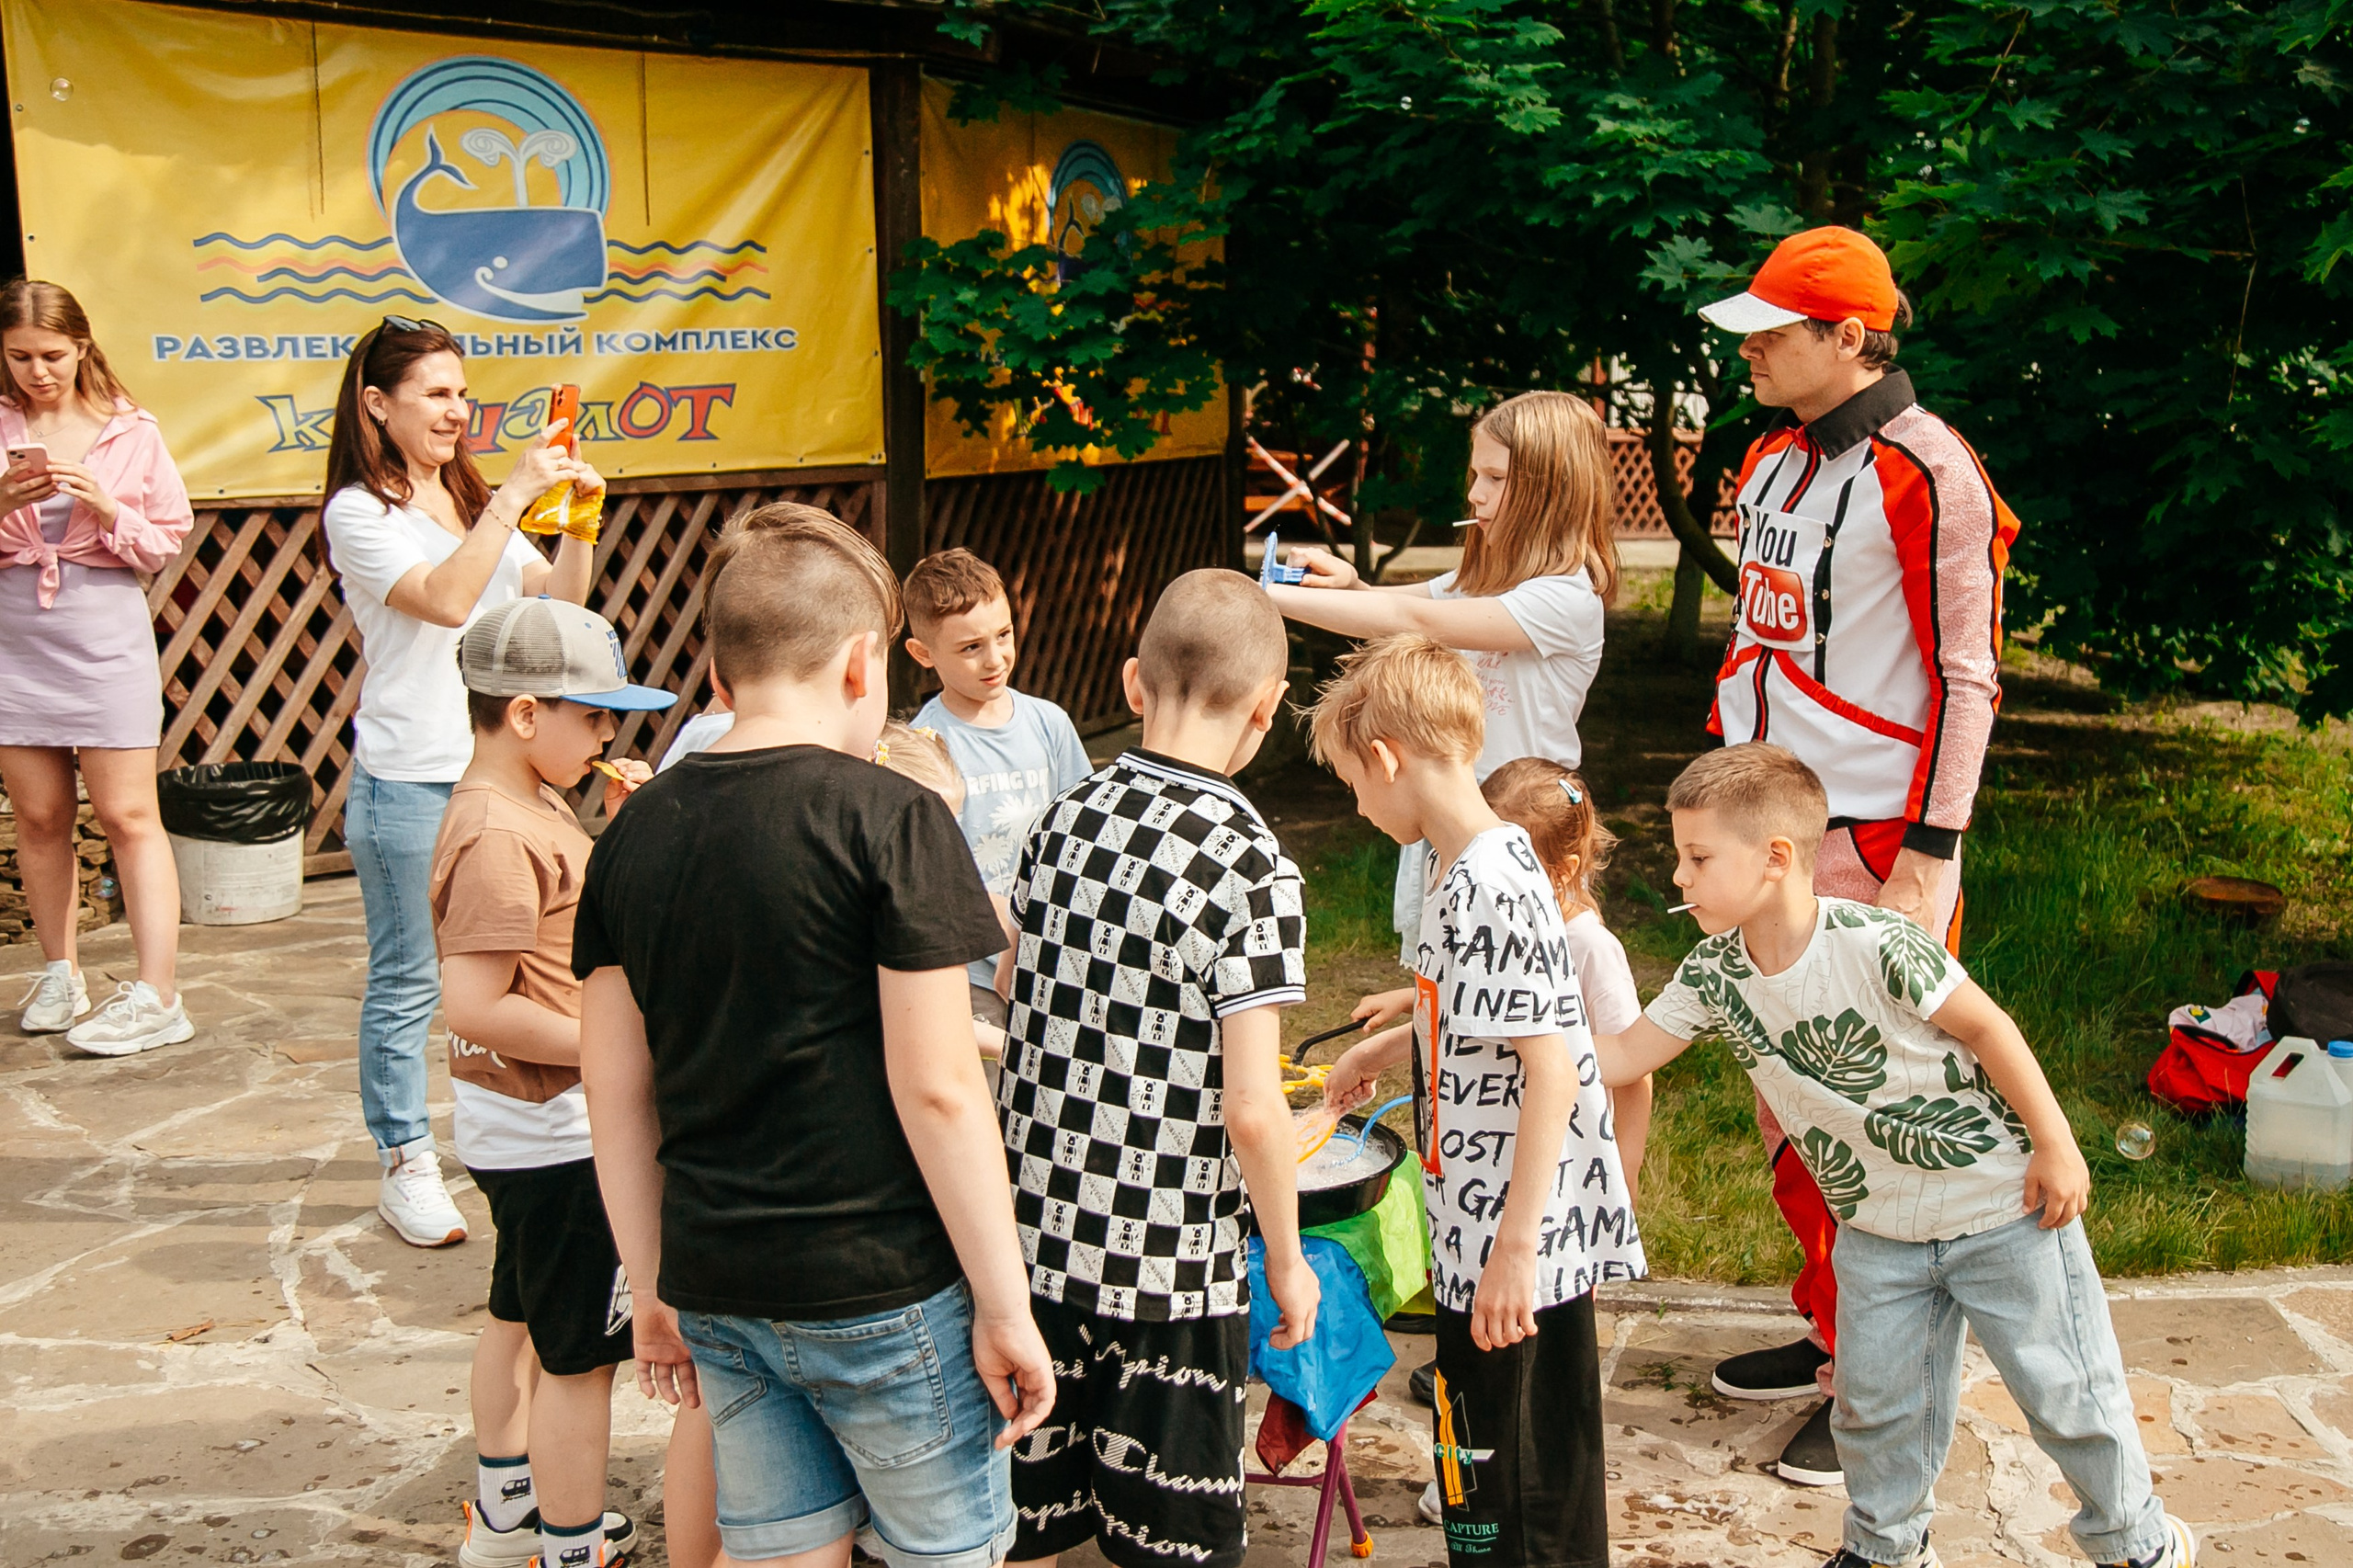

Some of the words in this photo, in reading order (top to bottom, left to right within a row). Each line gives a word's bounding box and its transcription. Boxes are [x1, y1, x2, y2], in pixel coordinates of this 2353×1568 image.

[154, 326, 584, 359] РАЗВЛЕКЛЬНЫЙ
[597, 328, 797, 355] КОМПЛЕКС
[1756, 511, 1797, 567] You
[1745, 568, 1799, 631] Tube
[1438, 1067, 1522, 1110] EVER
[1439, 1129, 1516, 1167] OST
[1444, 1519, 1499, 1535] CAPTURE
